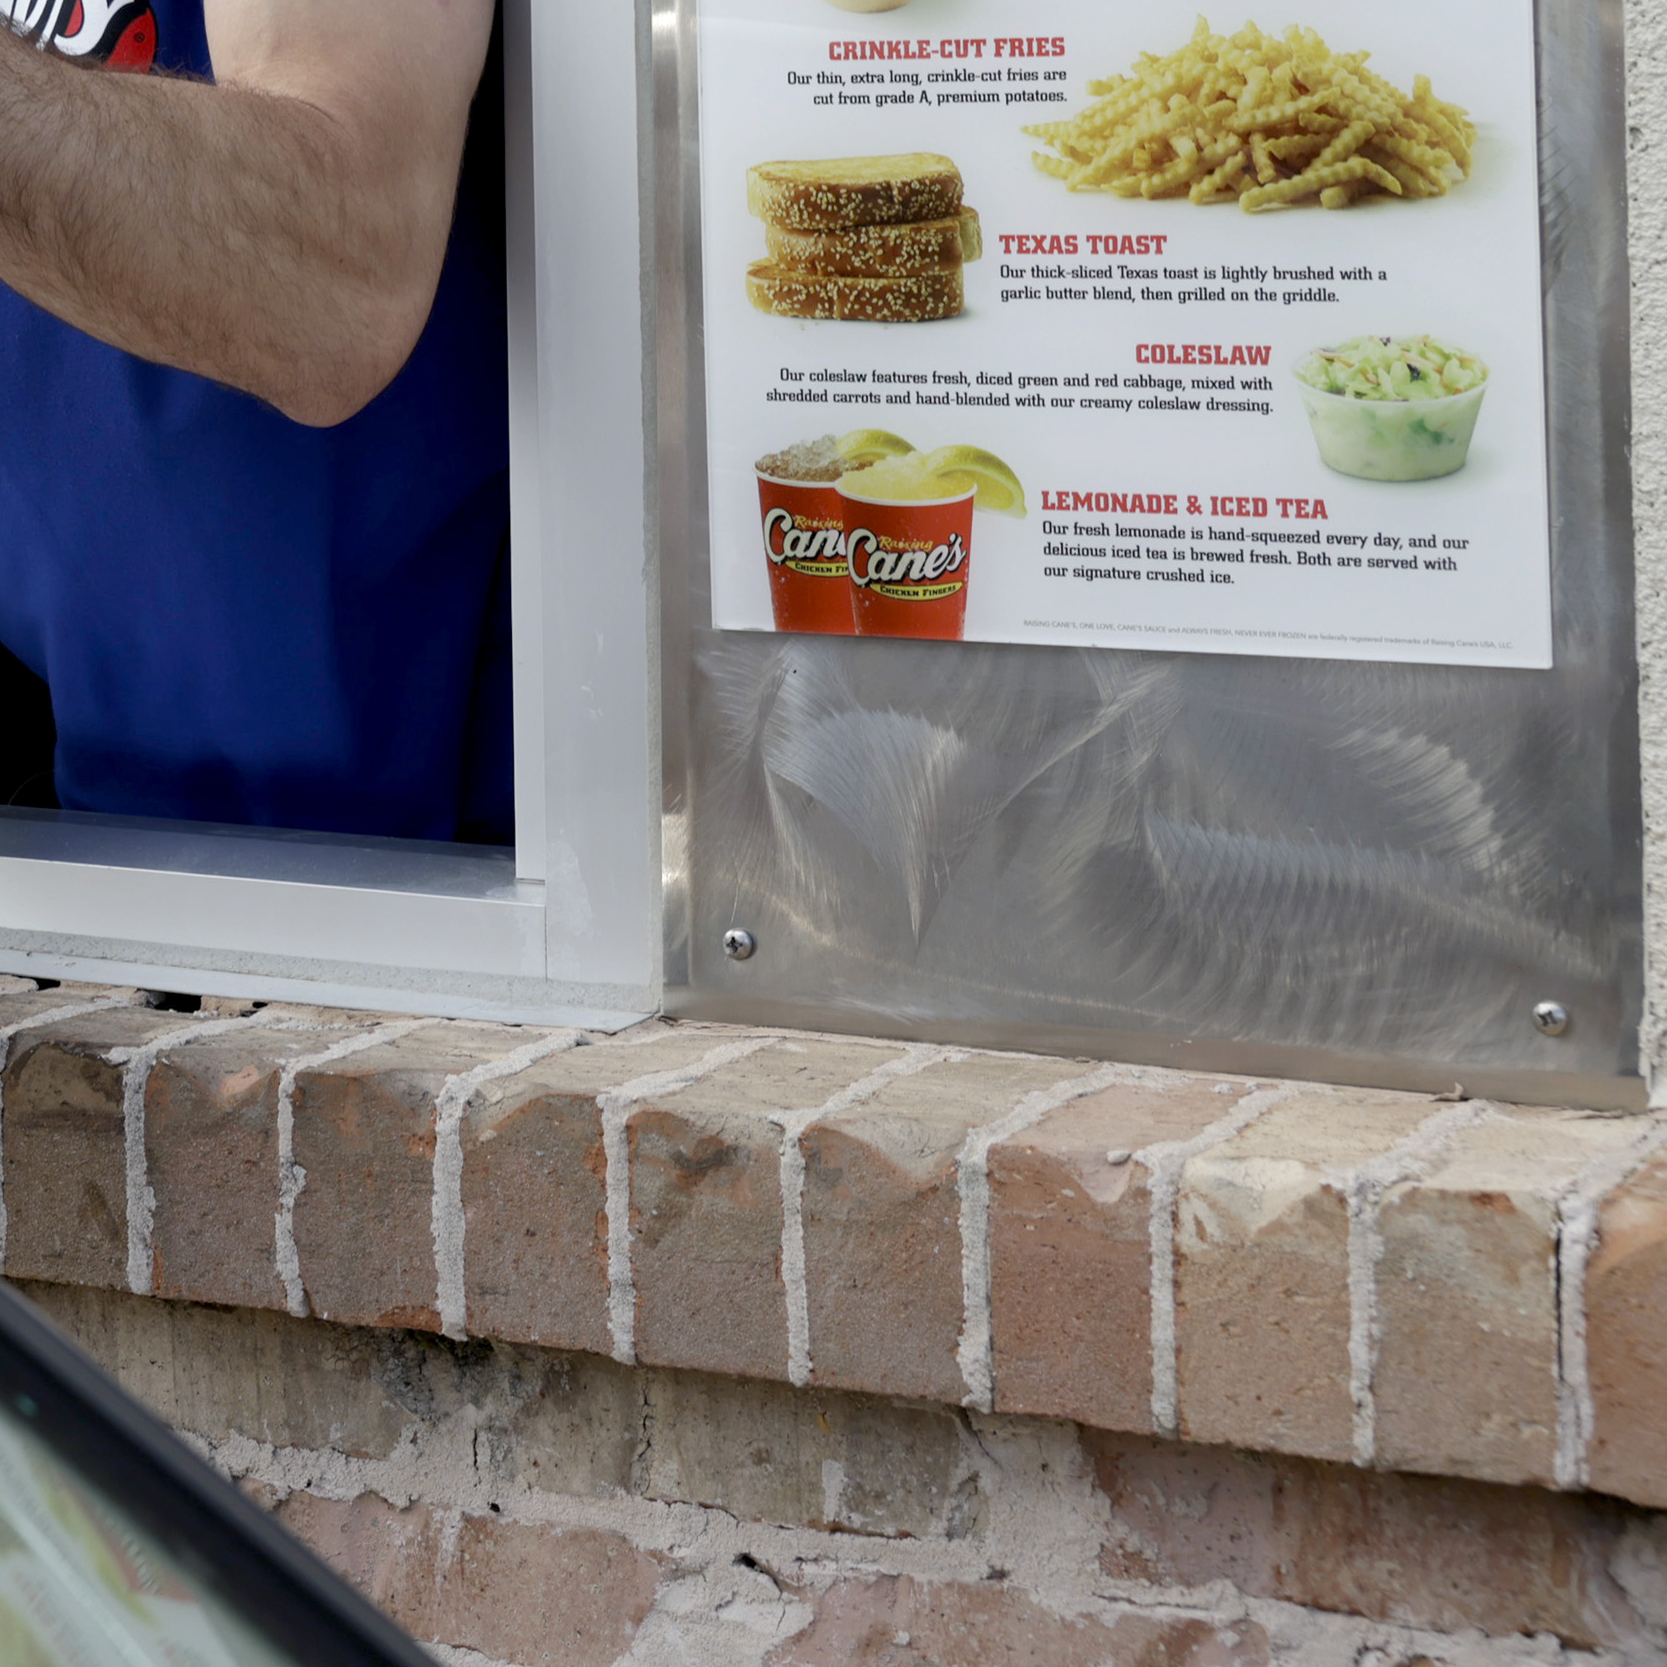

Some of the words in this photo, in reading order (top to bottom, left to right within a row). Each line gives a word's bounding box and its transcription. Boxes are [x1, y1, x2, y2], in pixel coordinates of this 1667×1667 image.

[828, 38, 987, 61] CRINKLE-CUT
[993, 36, 1066, 58] FRIES
[787, 71, 812, 85] Our
[817, 71, 847, 88] thin,
[850, 71, 885, 84] extra
[889, 69, 922, 86] long,
[927, 68, 1002, 83] crinkle-cut
[1007, 67, 1039, 81] fries
[1043, 71, 1067, 81] are
[813, 93, 833, 105] cut
[838, 91, 871, 105] from
[875, 90, 915, 108] grade
[919, 90, 932, 106] A,
[937, 90, 1000, 107] premium
[1004, 90, 1068, 106] potatoes.
[998, 234, 1079, 255] TEXAS
[1086, 235, 1168, 255] TOAST
[1000, 264, 1027, 279] Our
[1031, 264, 1113, 279] thick-sliced
[1116, 265, 1159, 279] Texas
[1163, 267, 1198, 279] toast
[1203, 266, 1217, 279] is
[1221, 265, 1268, 283] lightly
[1272, 265, 1334, 281] brushed
[1339, 266, 1373, 281] with
[1378, 271, 1387, 281] a
[1135, 344, 1272, 366] COLESLAW
[1041, 490, 1178, 515] LEMONADE
[1185, 495, 1203, 516] &
[1210, 496, 1268, 518] ICED
[1275, 498, 1329, 520] TEA
[795, 515, 843, 530] Raising
[764, 508, 847, 565] Can
[879, 536, 933, 551] Raising
[1042, 520, 1069, 535] Our
[1073, 521, 1110, 537] fresh
[1115, 523, 1186, 540] lemonade
[1191, 527, 1204, 540] is
[1208, 526, 1321, 546] hand-squeezed
[1326, 534, 1368, 549] every
[1373, 532, 1403, 551] day,
[1408, 534, 1437, 549] and
[1442, 539, 1469, 550] our
[847, 528, 966, 588] Cane's
